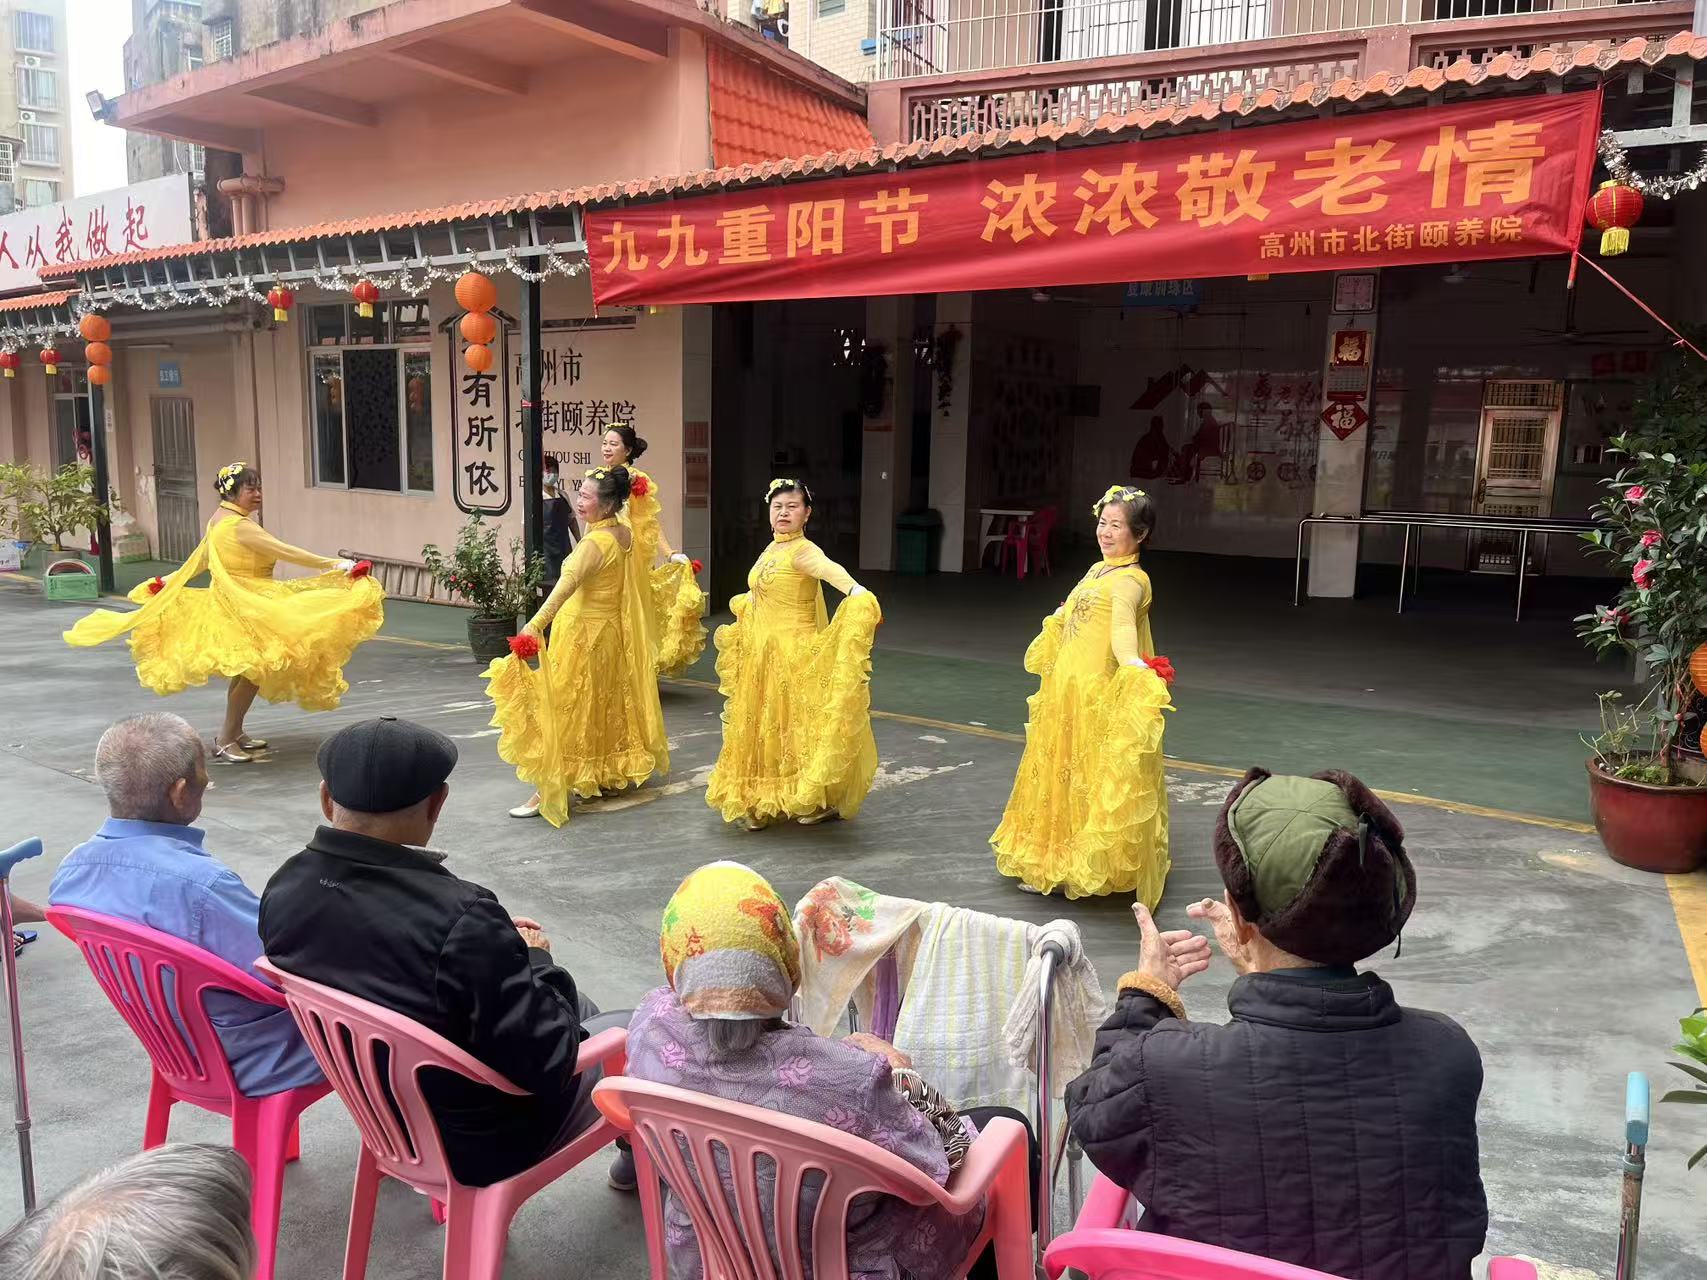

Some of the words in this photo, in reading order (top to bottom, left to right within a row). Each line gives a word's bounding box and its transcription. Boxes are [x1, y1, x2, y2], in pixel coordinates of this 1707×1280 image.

[602, 187, 929, 274] 九九重阳节
[980, 120, 1545, 243] 浓浓敬老情
[0, 196, 149, 269] 人从我做起
[1258, 215, 1523, 259] 高州市北街颐养院
[1338, 336, 1362, 361] 福
[462, 338, 499, 496] 有所依
[1331, 404, 1356, 430] 福
[573, 452, 591, 465] SHI
